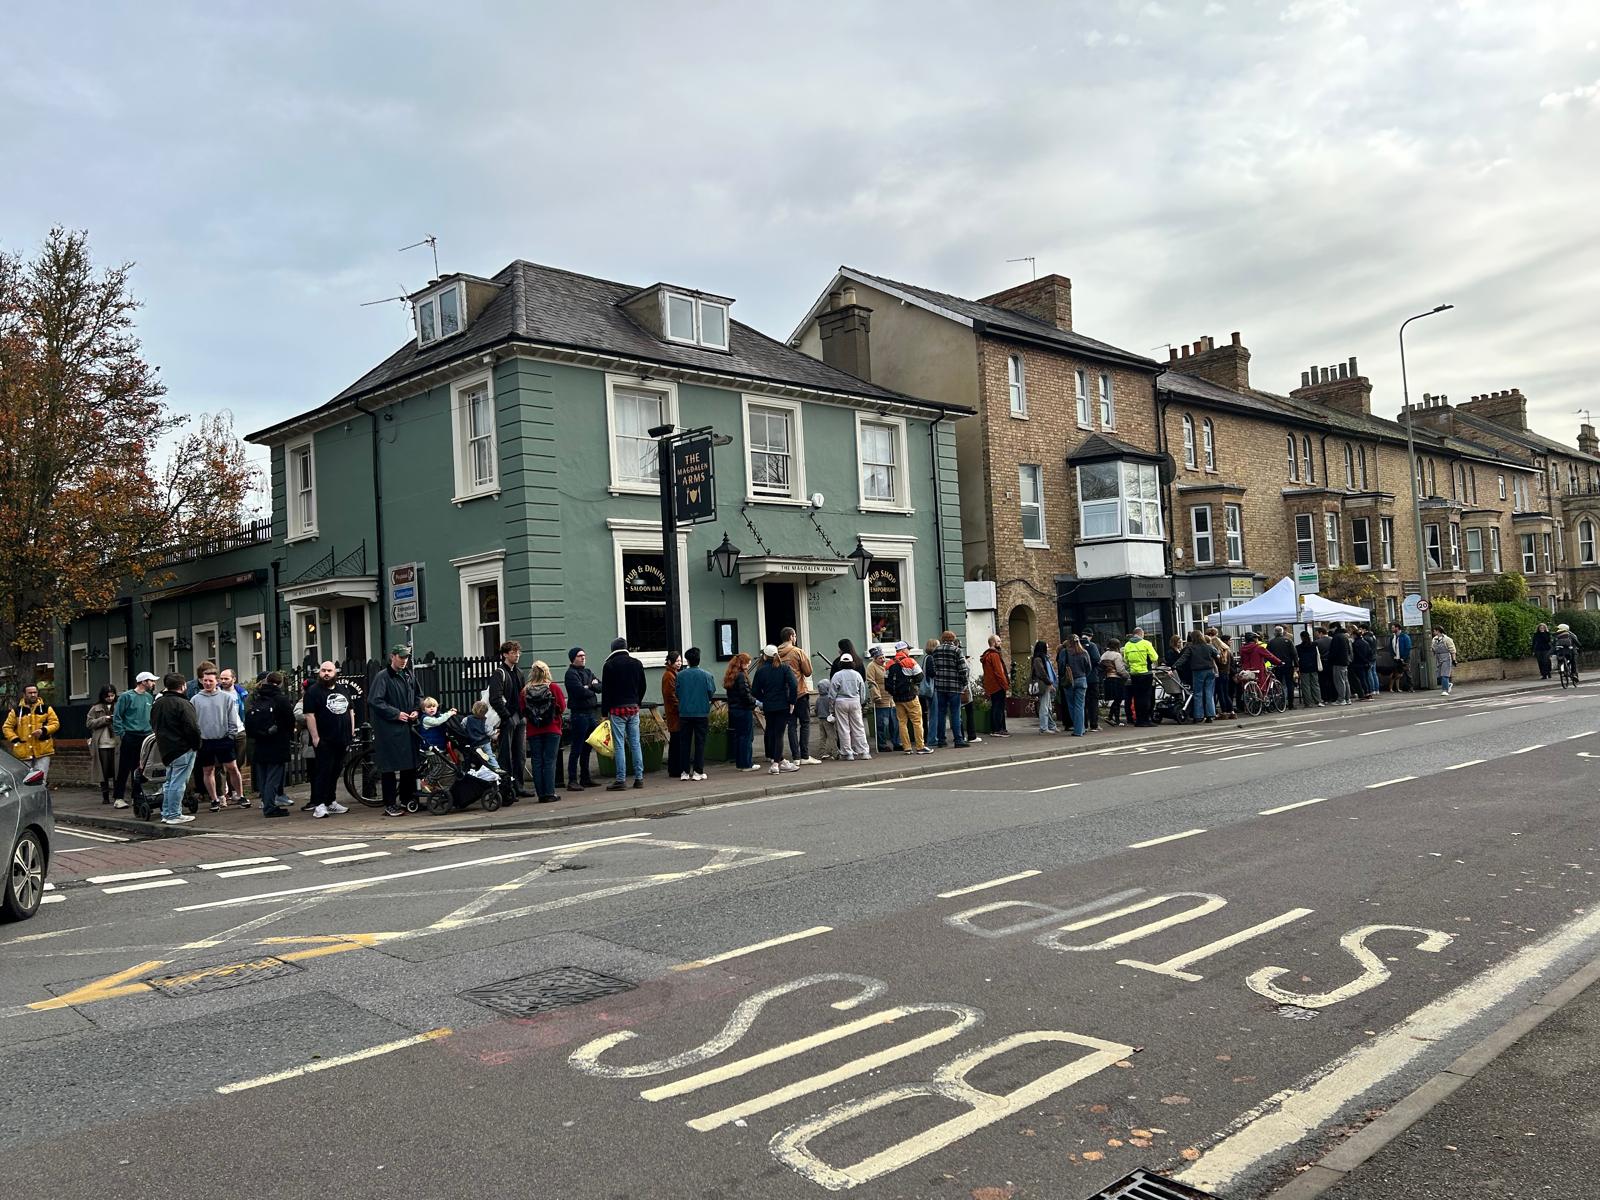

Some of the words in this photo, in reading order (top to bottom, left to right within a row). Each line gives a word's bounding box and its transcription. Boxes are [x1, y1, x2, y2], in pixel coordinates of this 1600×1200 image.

[684, 452, 700, 465] THE
[677, 463, 708, 476] MAGDALEN
[682, 472, 705, 486] ARMS
[625, 568, 638, 584] PUB
[637, 565, 644, 573] &
[868, 570, 880, 584] PUB
[880, 569, 897, 584] SHOP
[943, 887, 1455, 1009] STOP
[567, 972, 1137, 1192] BUS
